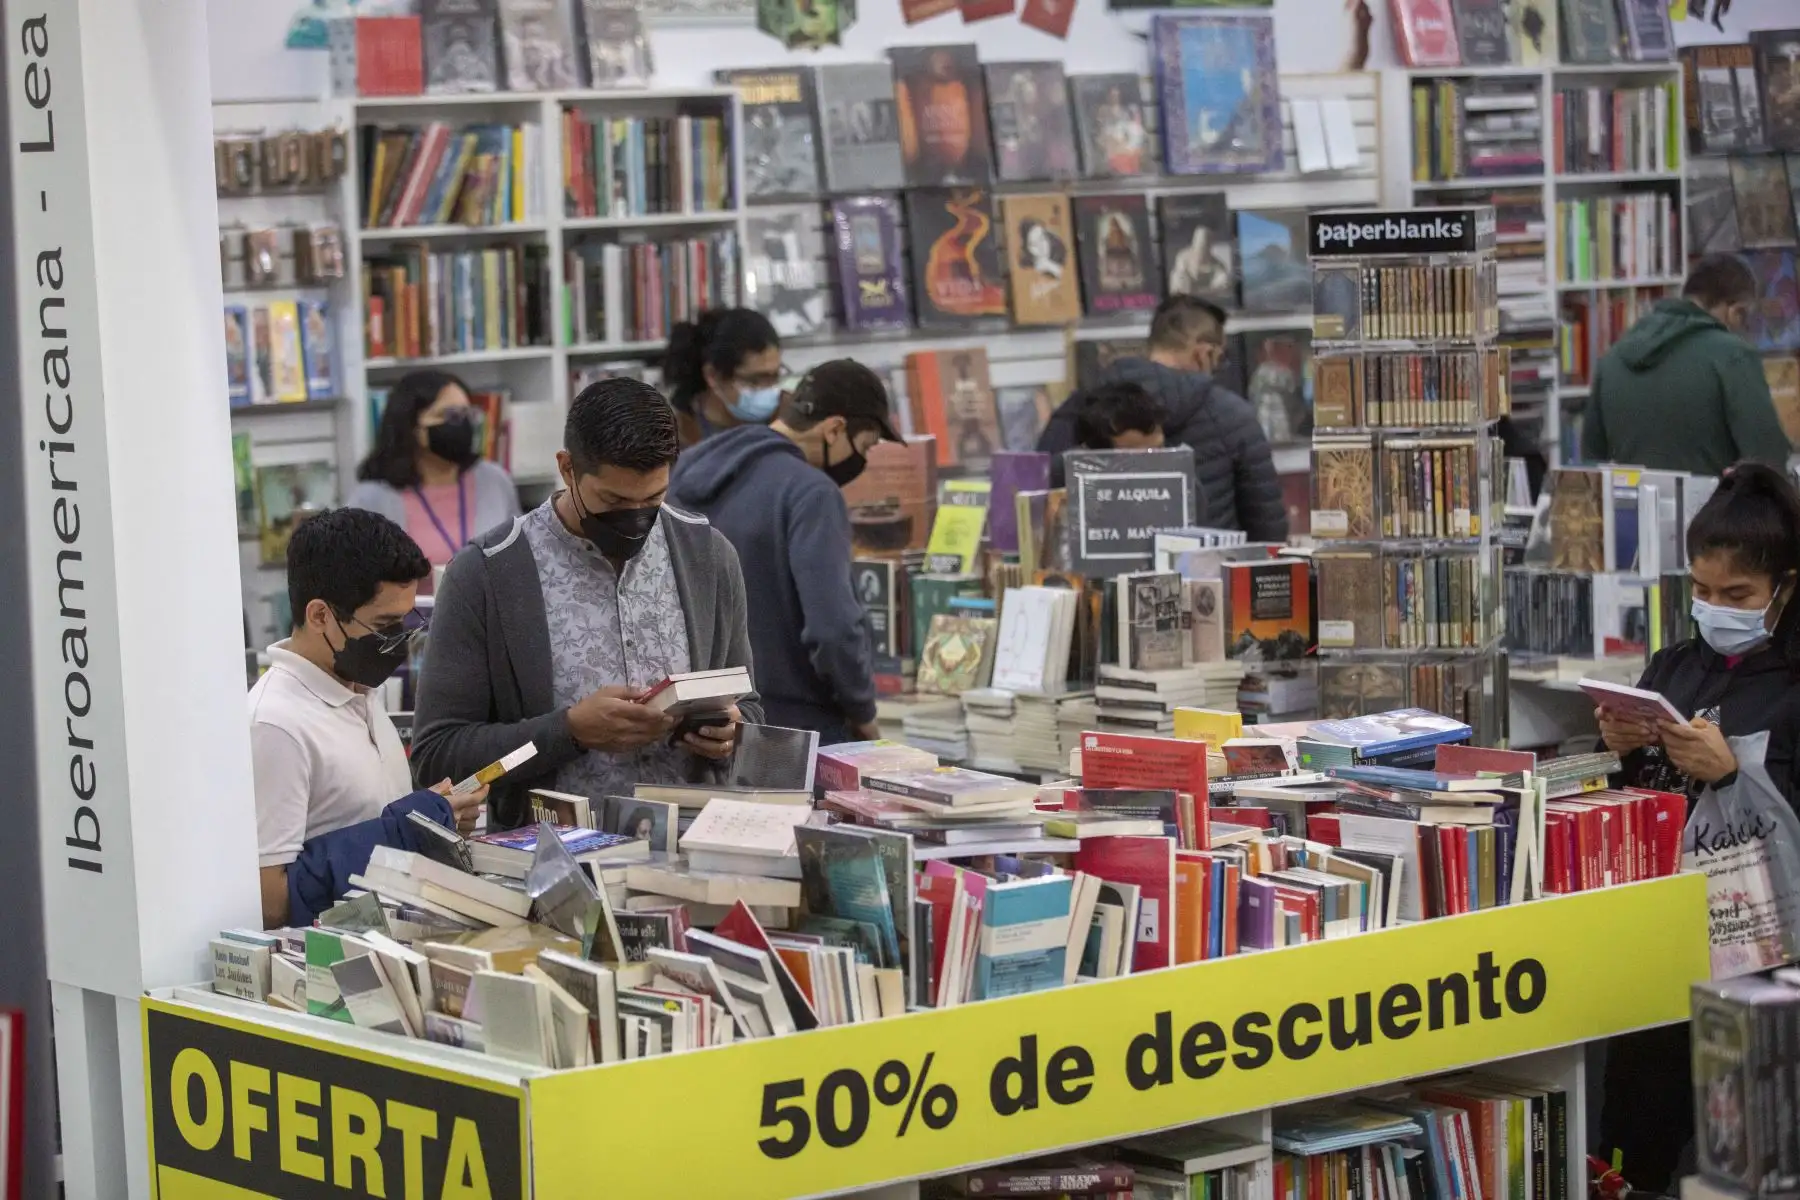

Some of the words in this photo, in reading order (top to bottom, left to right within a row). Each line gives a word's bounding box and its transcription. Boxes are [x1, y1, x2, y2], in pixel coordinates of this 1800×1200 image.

[20, 13, 56, 153] Lea
[1316, 216, 1464, 249] paperblanks
[37, 247, 104, 873] Iberoamericana
[1087, 527, 1121, 541] ESTA
[1096, 488, 1113, 502] SE
[1117, 487, 1171, 502] ALQUILA
[170, 1047, 491, 1200] OFERTA
[758, 1051, 957, 1160] 50%
[990, 1034, 1094, 1116] de
[1125, 951, 1547, 1091] descuento
